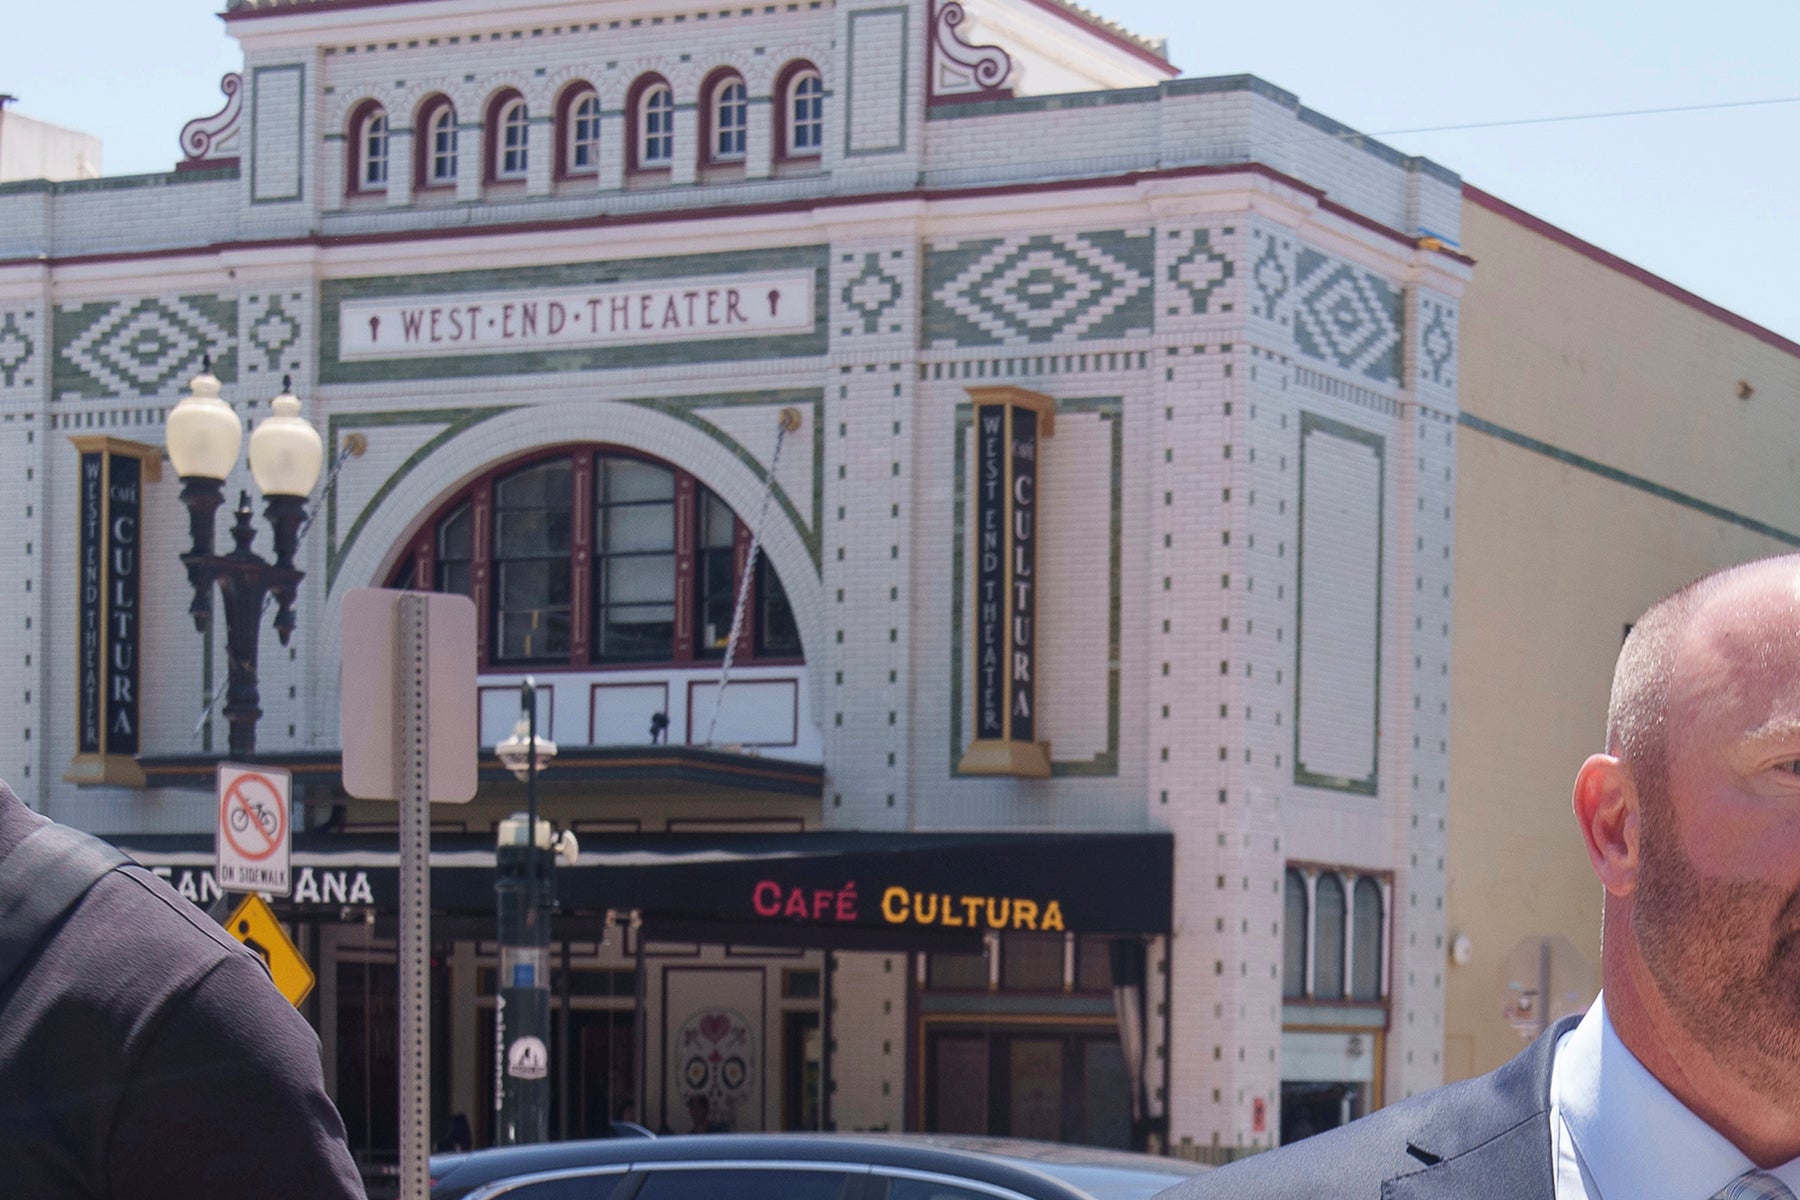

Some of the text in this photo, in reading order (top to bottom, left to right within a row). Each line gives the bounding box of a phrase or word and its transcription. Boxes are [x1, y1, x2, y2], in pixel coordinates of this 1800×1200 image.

[401, 289, 749, 342] WEST END THEATER
[86, 462, 100, 744] WEST END THEATER
[113, 516, 134, 734] CULTURA
[982, 416, 1001, 730] WEST END THEATER
[1013, 475, 1033, 718] CULTURA
[222, 865, 235, 881] ON
[240, 866, 287, 887] SIDEWALK
[294, 867, 374, 903] ANA
[881, 886, 1066, 931] CULTURA
